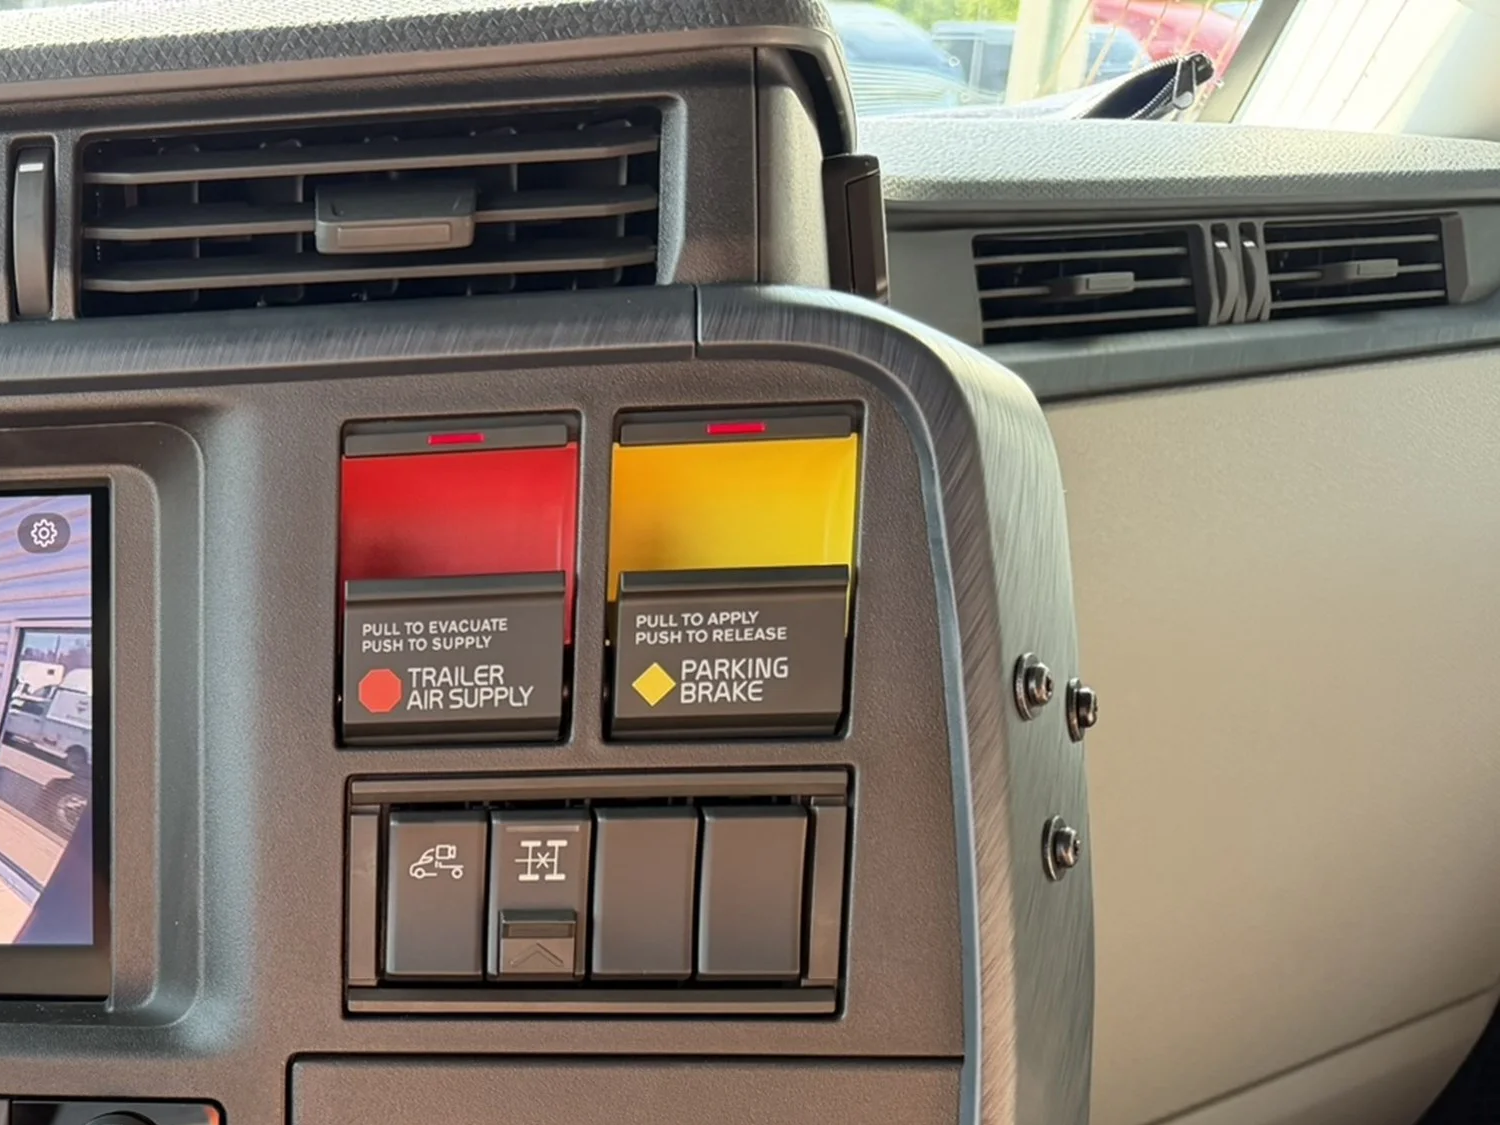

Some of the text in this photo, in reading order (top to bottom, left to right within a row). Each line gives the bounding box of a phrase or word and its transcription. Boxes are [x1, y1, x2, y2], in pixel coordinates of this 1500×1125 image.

[362, 617, 508, 636] PULL TO EVACUATE
[635, 611, 760, 628] PULL TO APPLY
[362, 636, 493, 653] PUSH TO SUPPLY
[635, 626, 788, 645] PUSH TO RELEASE
[407, 664, 505, 688] TRAILER
[681, 656, 789, 681] PARKING
[406, 685, 534, 710] AIR SUPPLY
[680, 680, 764, 704] BRAKE
